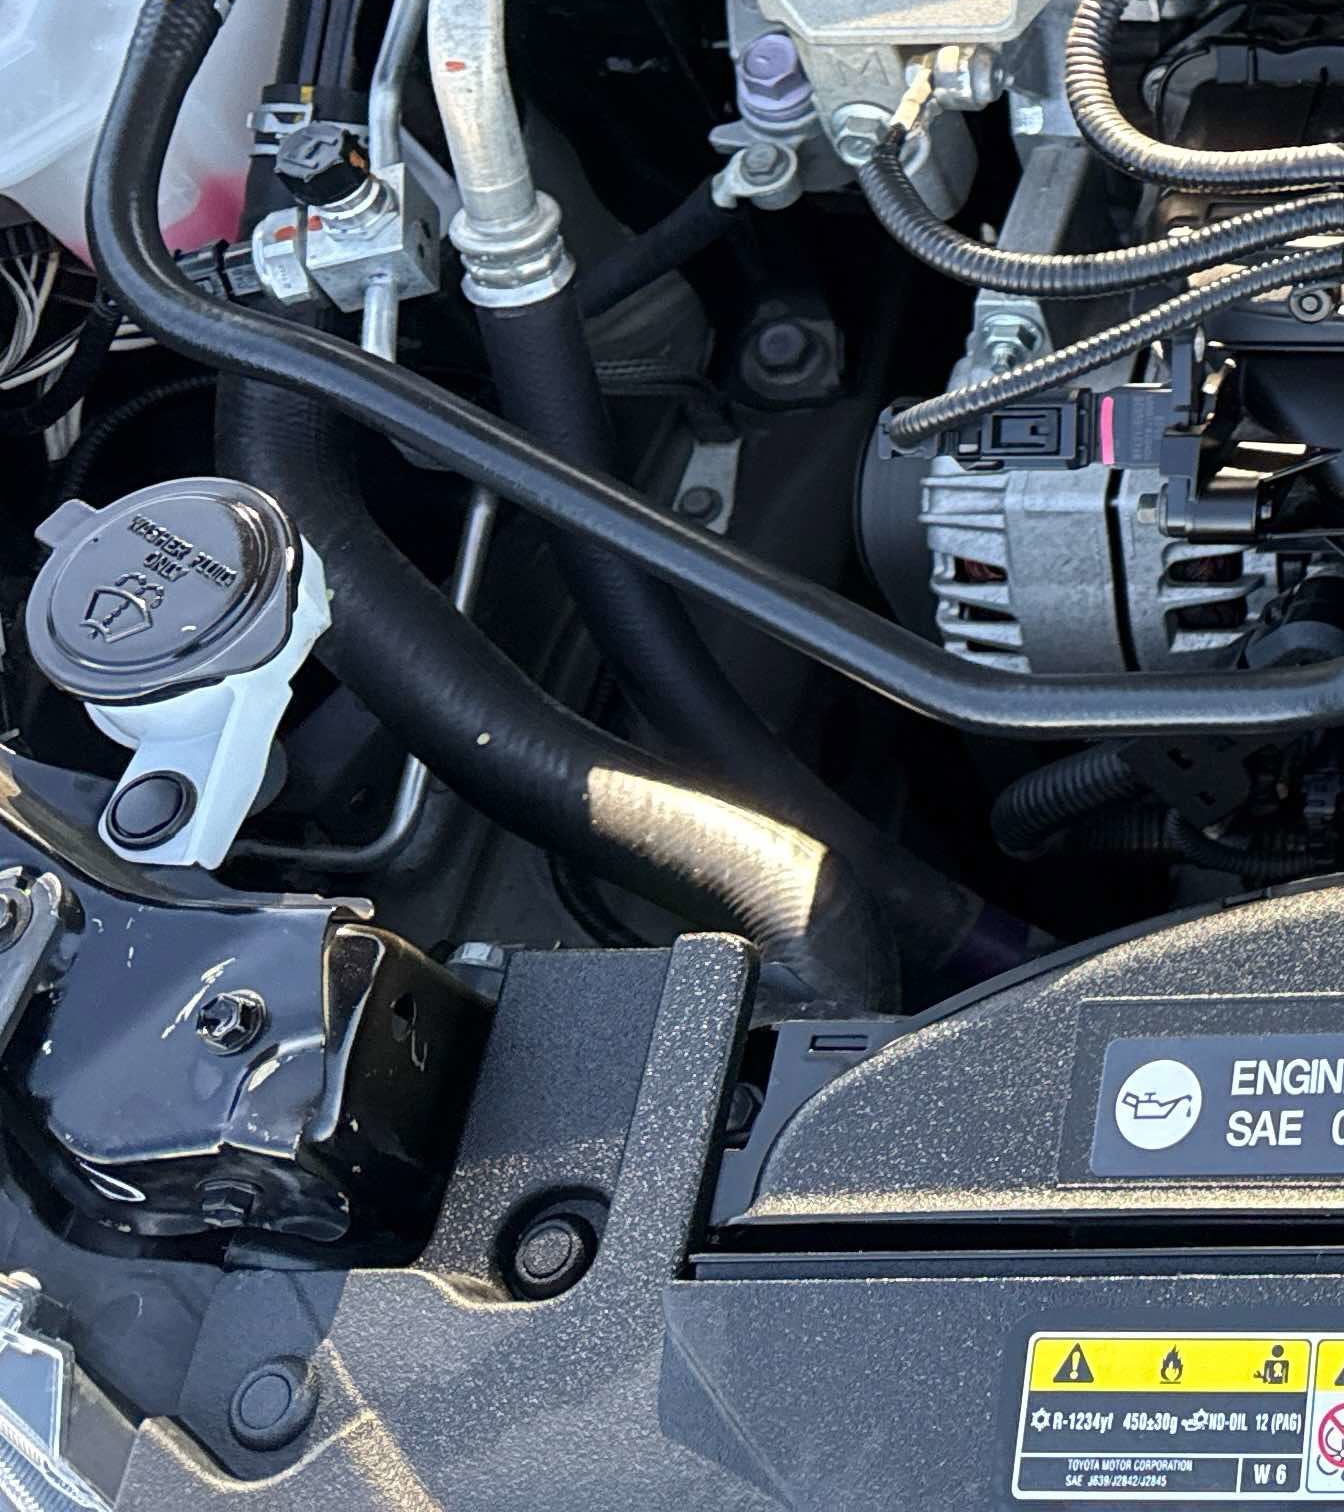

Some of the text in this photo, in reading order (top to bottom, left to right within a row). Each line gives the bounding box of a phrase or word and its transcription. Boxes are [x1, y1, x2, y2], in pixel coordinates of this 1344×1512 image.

[143, 551, 190, 582] ONLY
[1226, 1110, 1304, 1147] SAE
[1053, 1412, 1301, 1434] R-1234yf 450±30g ND-OIL 12 (PAG)
[1068, 1459, 1193, 1472] TOYOTA MOTOR CORPORATION
[1254, 1464, 1287, 1485] W 6
[1065, 1475, 1082, 1487] SAE
